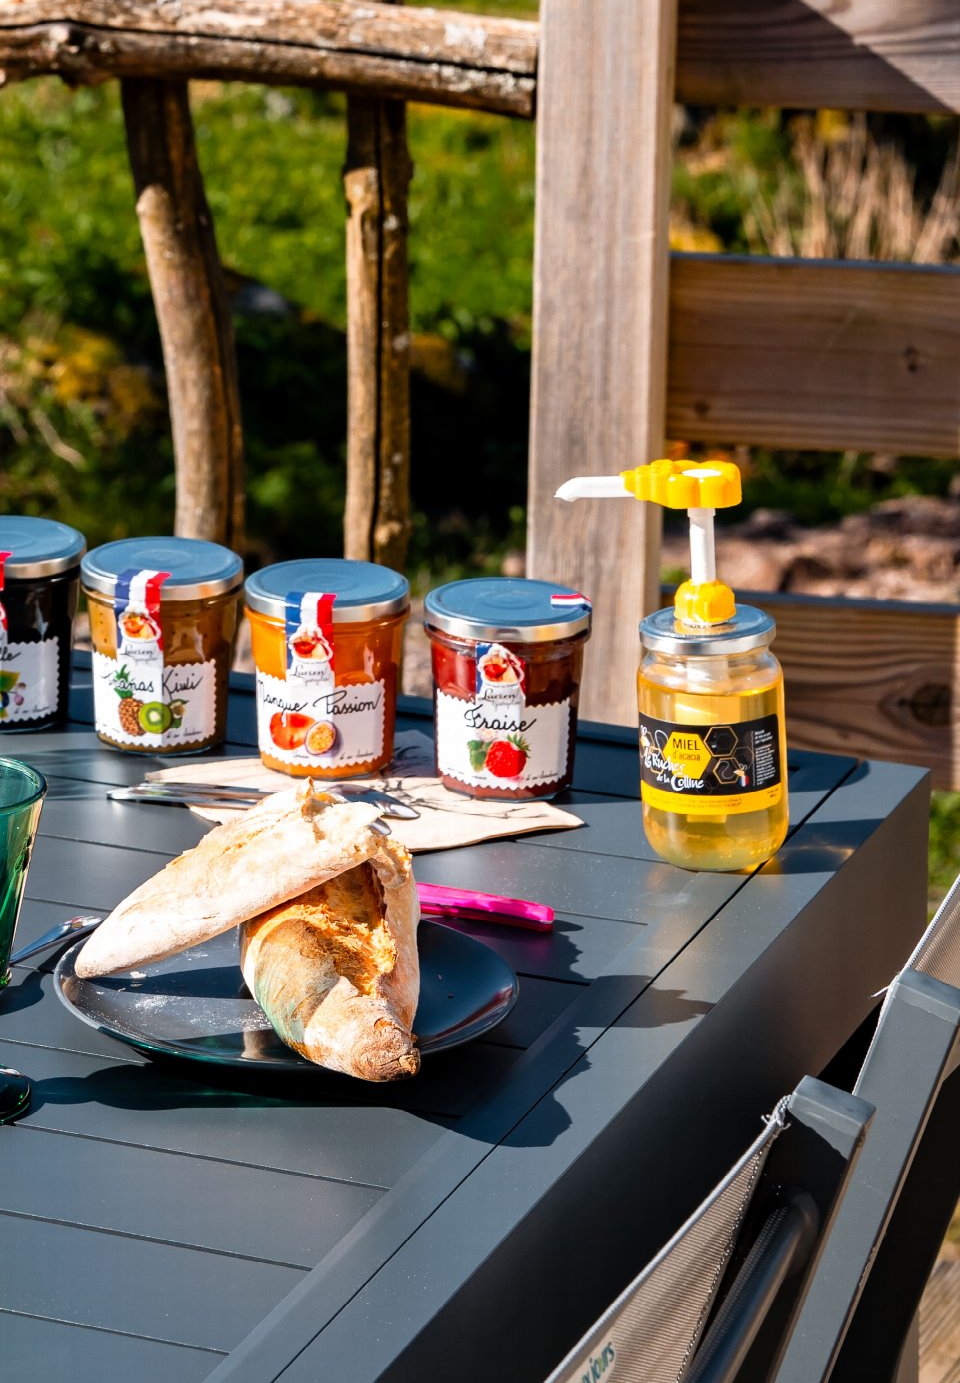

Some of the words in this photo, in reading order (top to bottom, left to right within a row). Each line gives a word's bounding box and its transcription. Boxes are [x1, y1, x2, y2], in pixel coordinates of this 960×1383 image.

[290, 664, 327, 678] Lucien
[162, 669, 204, 701] Kiwi
[313, 689, 382, 716] Passion
[478, 687, 519, 704] Lucien
[464, 704, 538, 732] Fraise
[672, 738, 701, 751] MIEL
[652, 753, 687, 773] Rucher
[670, 772, 705, 792] Colline
